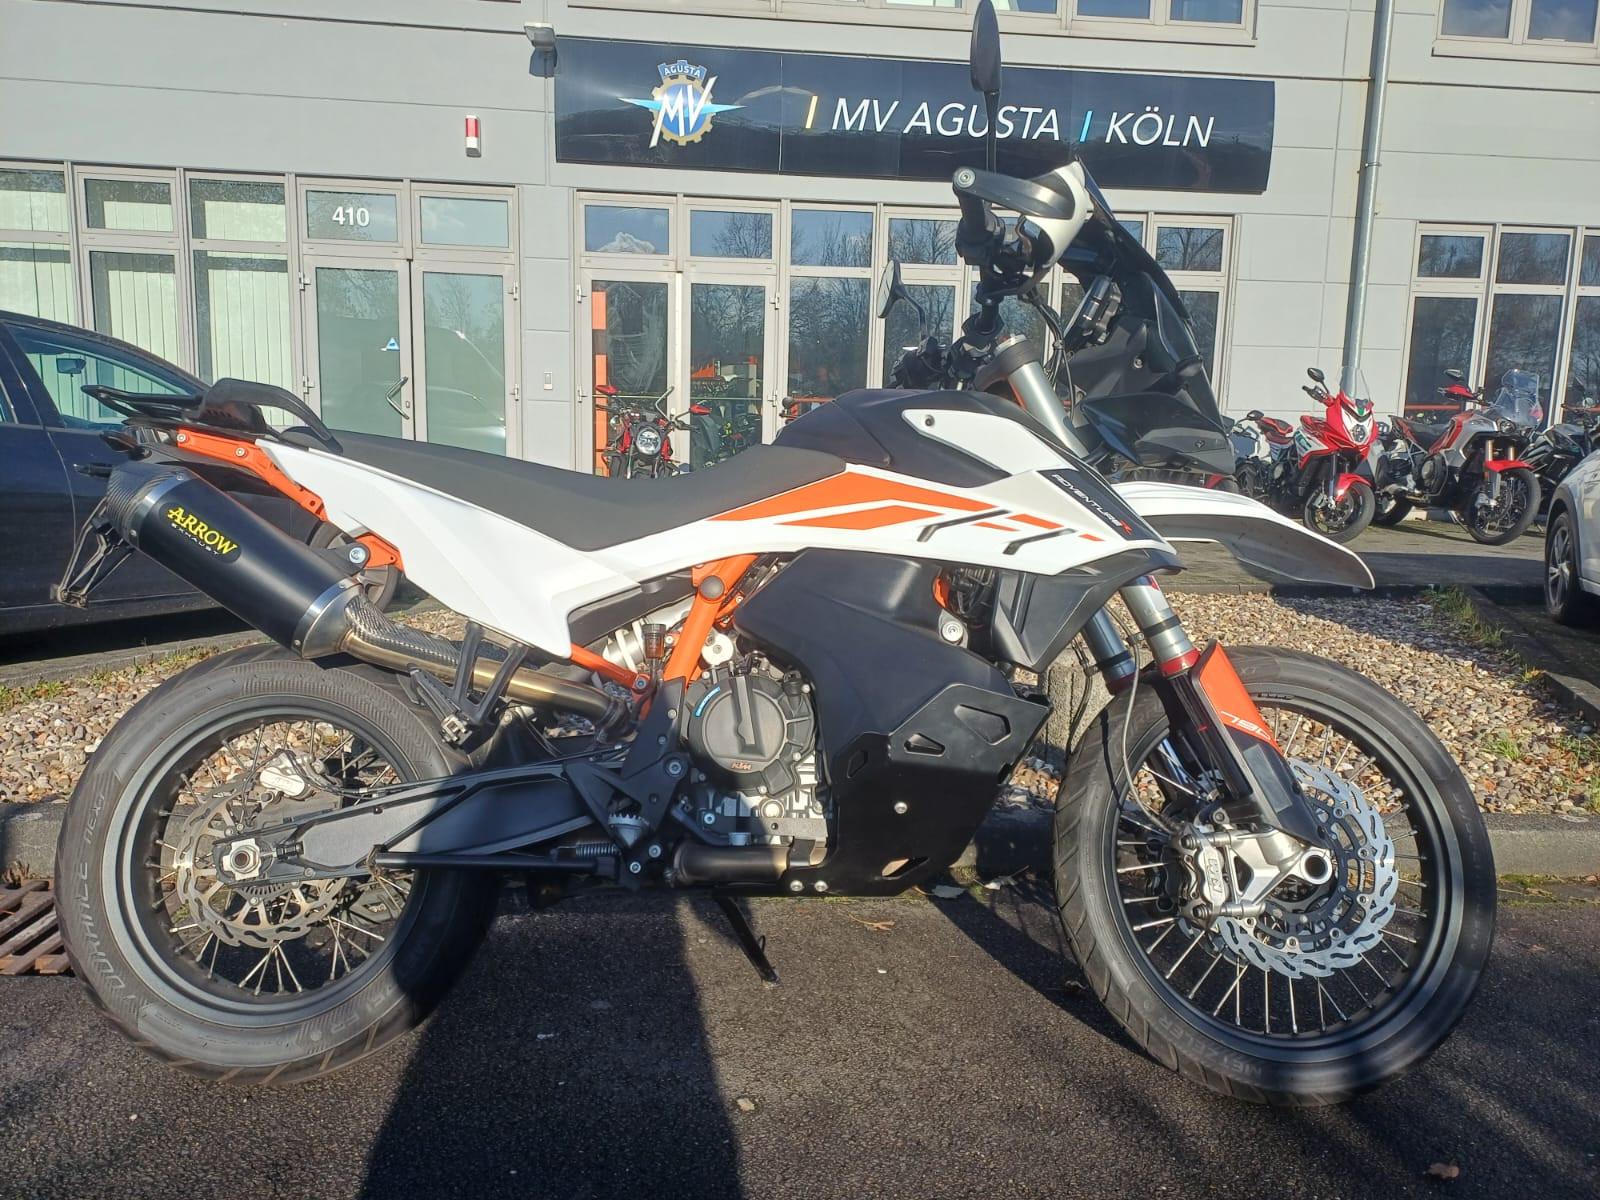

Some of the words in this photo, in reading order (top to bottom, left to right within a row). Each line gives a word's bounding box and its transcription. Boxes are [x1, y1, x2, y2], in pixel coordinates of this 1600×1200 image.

[663, 65, 701, 77] AGUSTA
[649, 75, 718, 148] MV
[831, 97, 900, 132] MV
[903, 102, 1061, 141] AGUSTA
[1104, 106, 1215, 148] KÖLN
[332, 206, 370, 227] 410
[1051, 473, 1123, 527] ADVENTURE
[167, 507, 238, 554] ARROW
